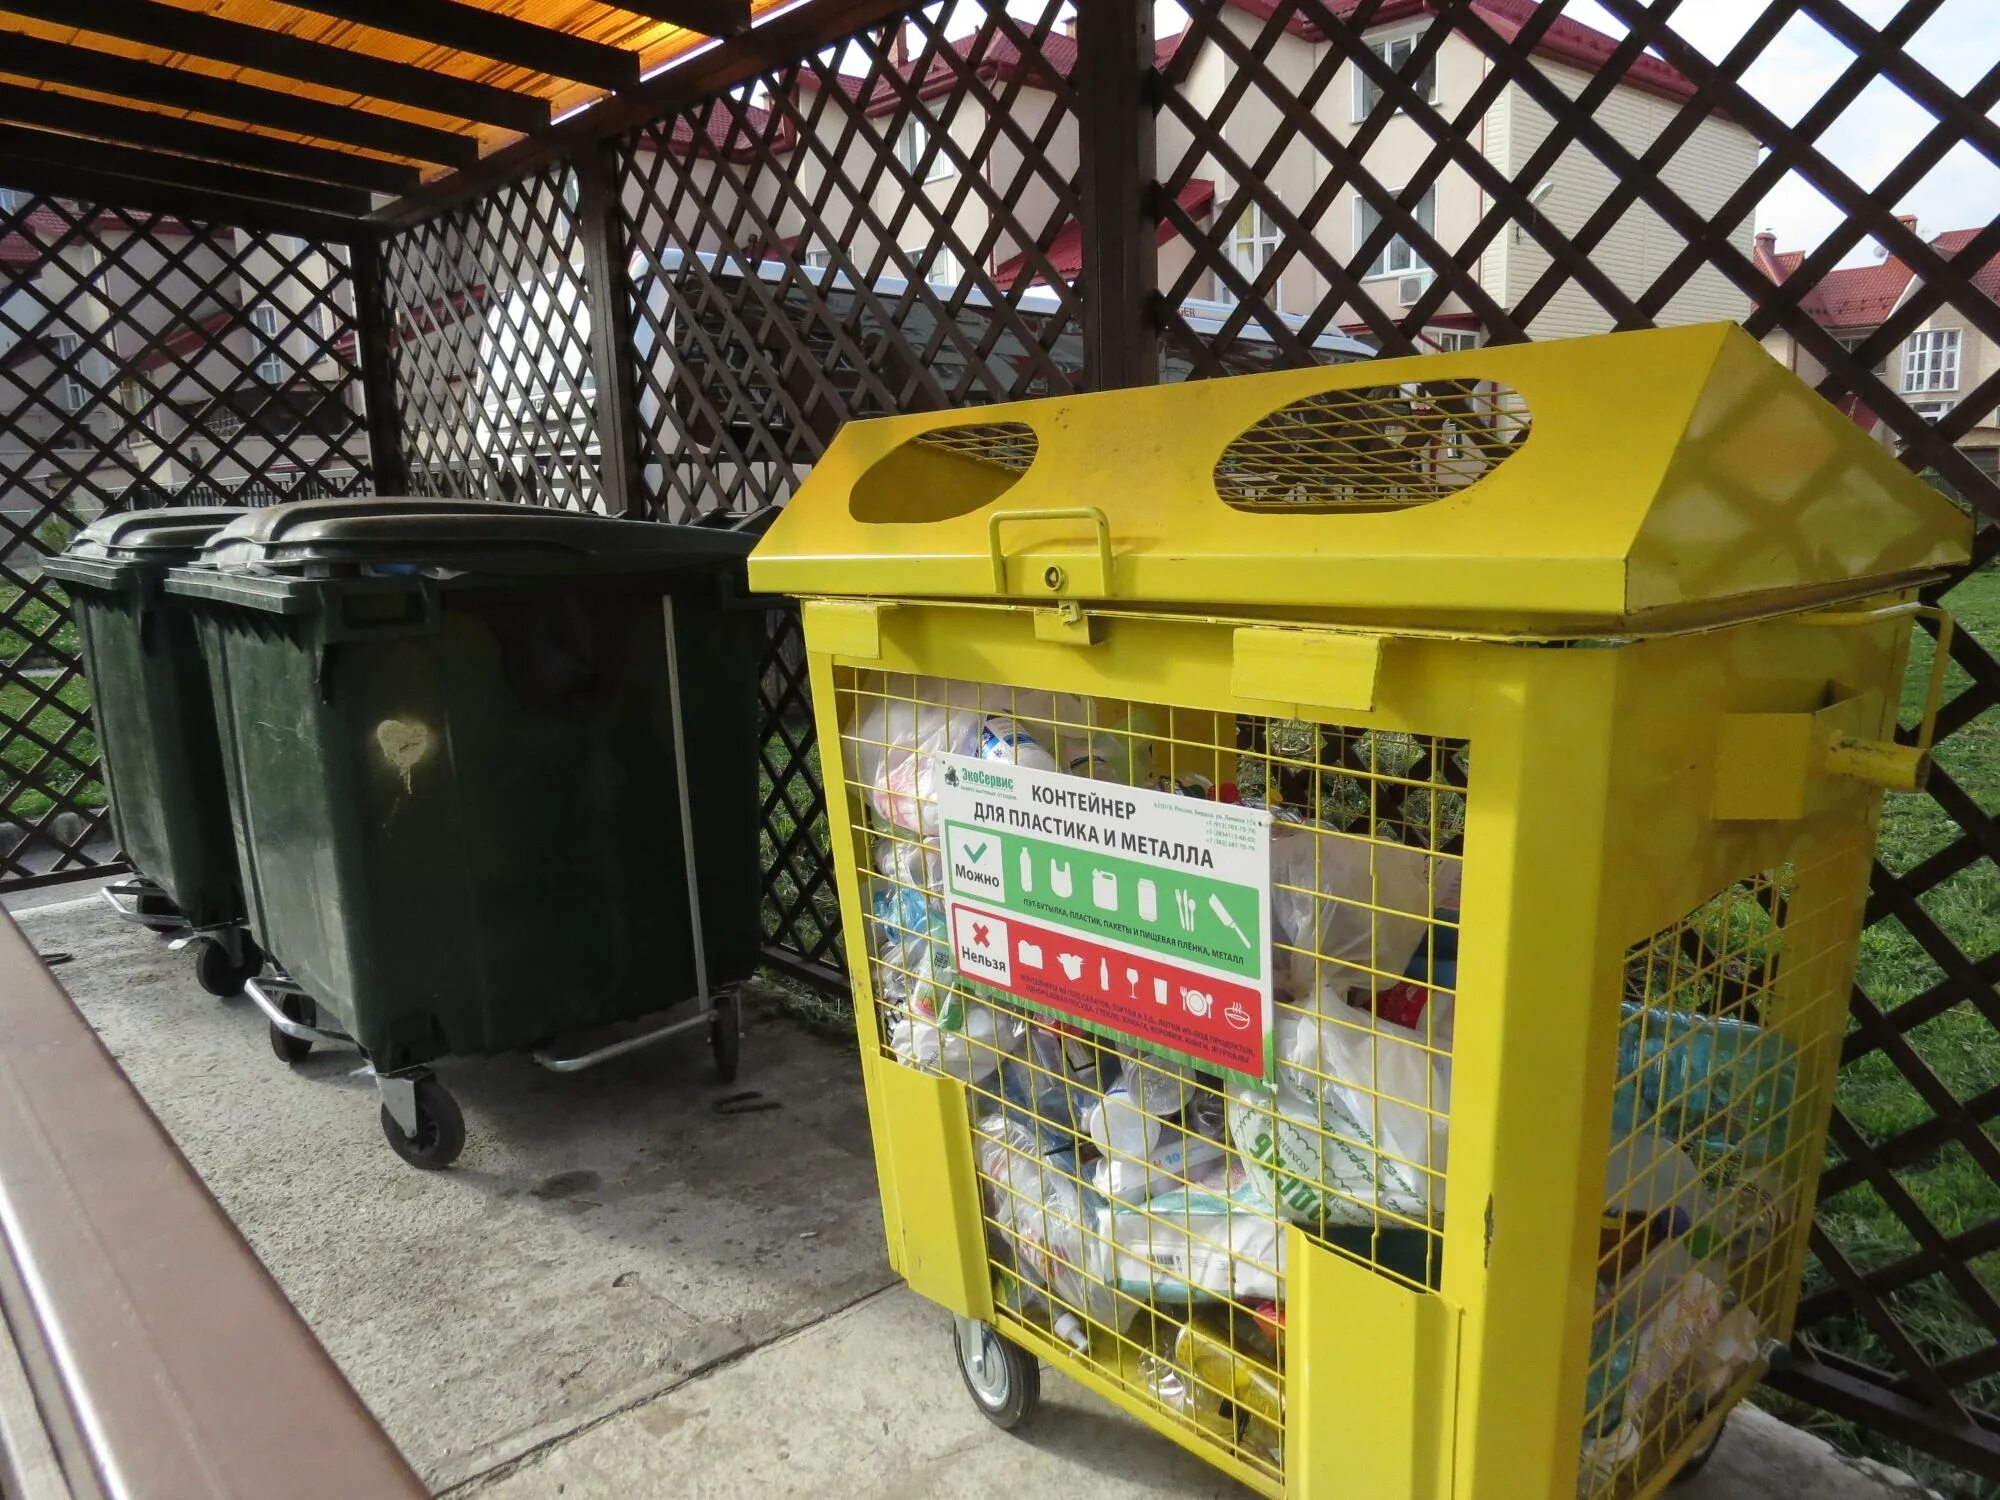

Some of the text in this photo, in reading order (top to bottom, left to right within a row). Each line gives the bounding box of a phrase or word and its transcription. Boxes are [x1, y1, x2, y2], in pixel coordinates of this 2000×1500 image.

[962, 768, 1014, 790] ЭкоСервис
[1031, 784, 1136, 819] КОНТЕЙНЕР
[972, 802, 1213, 870] ДЛЯ ПЛАСТИКА И МЕТАЛЛА
[954, 863, 1000, 888] Можно
[1022, 898, 1068, 918] ПЭТ-БУТЫЛКА,
[1103, 920, 1131, 935] ПАКЕТЫ
[1139, 930, 1176, 947] ПИЩЕВАЯ
[1211, 949, 1244, 966] МЕТАЛЛ
[961, 946, 1006, 972] Нельзя
